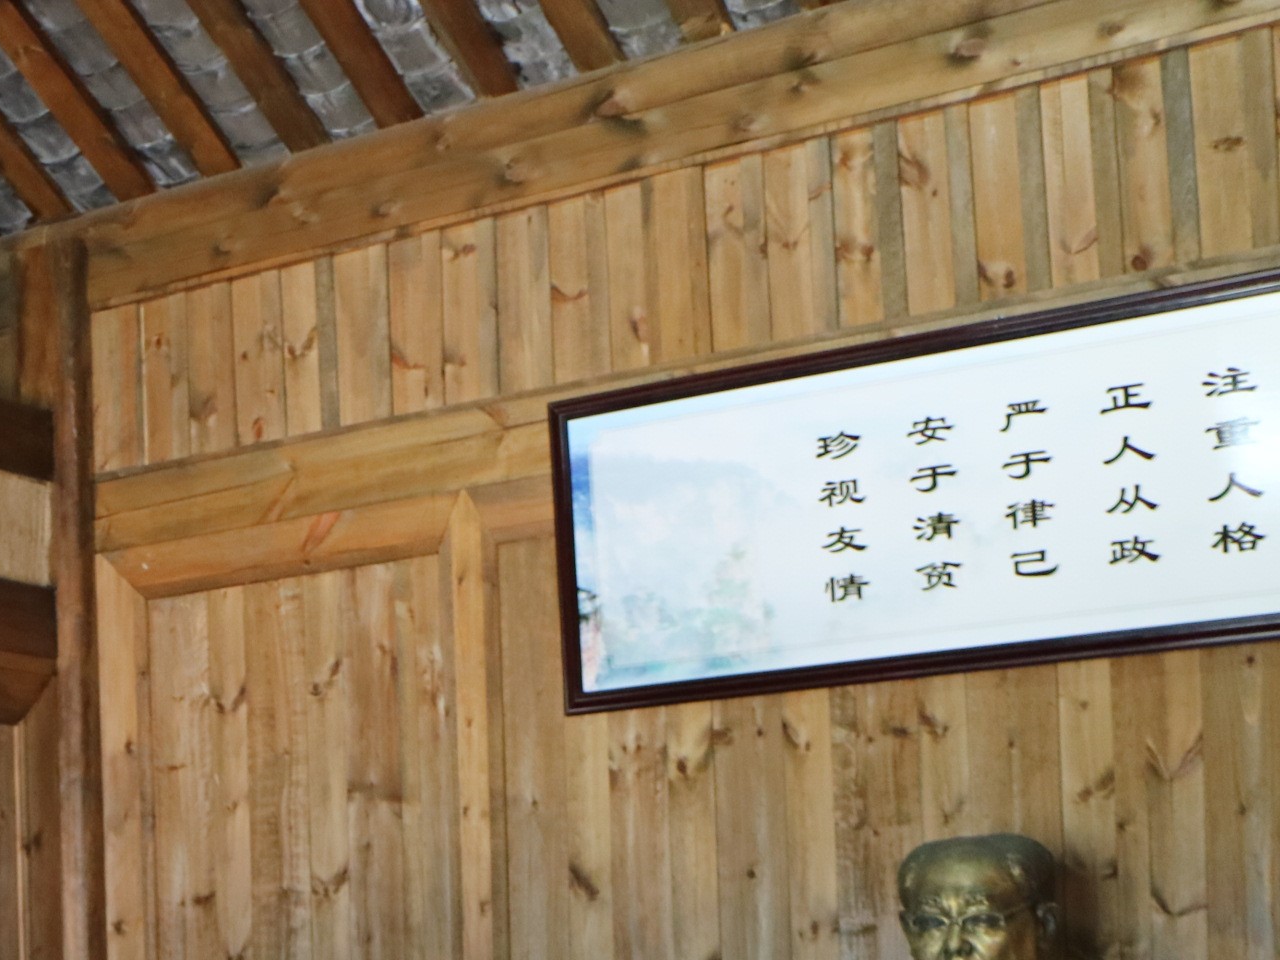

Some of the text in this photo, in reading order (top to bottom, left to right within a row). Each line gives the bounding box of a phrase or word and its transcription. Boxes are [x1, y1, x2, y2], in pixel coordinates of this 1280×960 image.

[815, 430, 870, 603] 珍视友情
[906, 415, 963, 592] 安于清贫
[999, 399, 1060, 577] 严于律己
[1099, 382, 1162, 565] 正人从政
[1201, 366, 1267, 553] 注重人格
